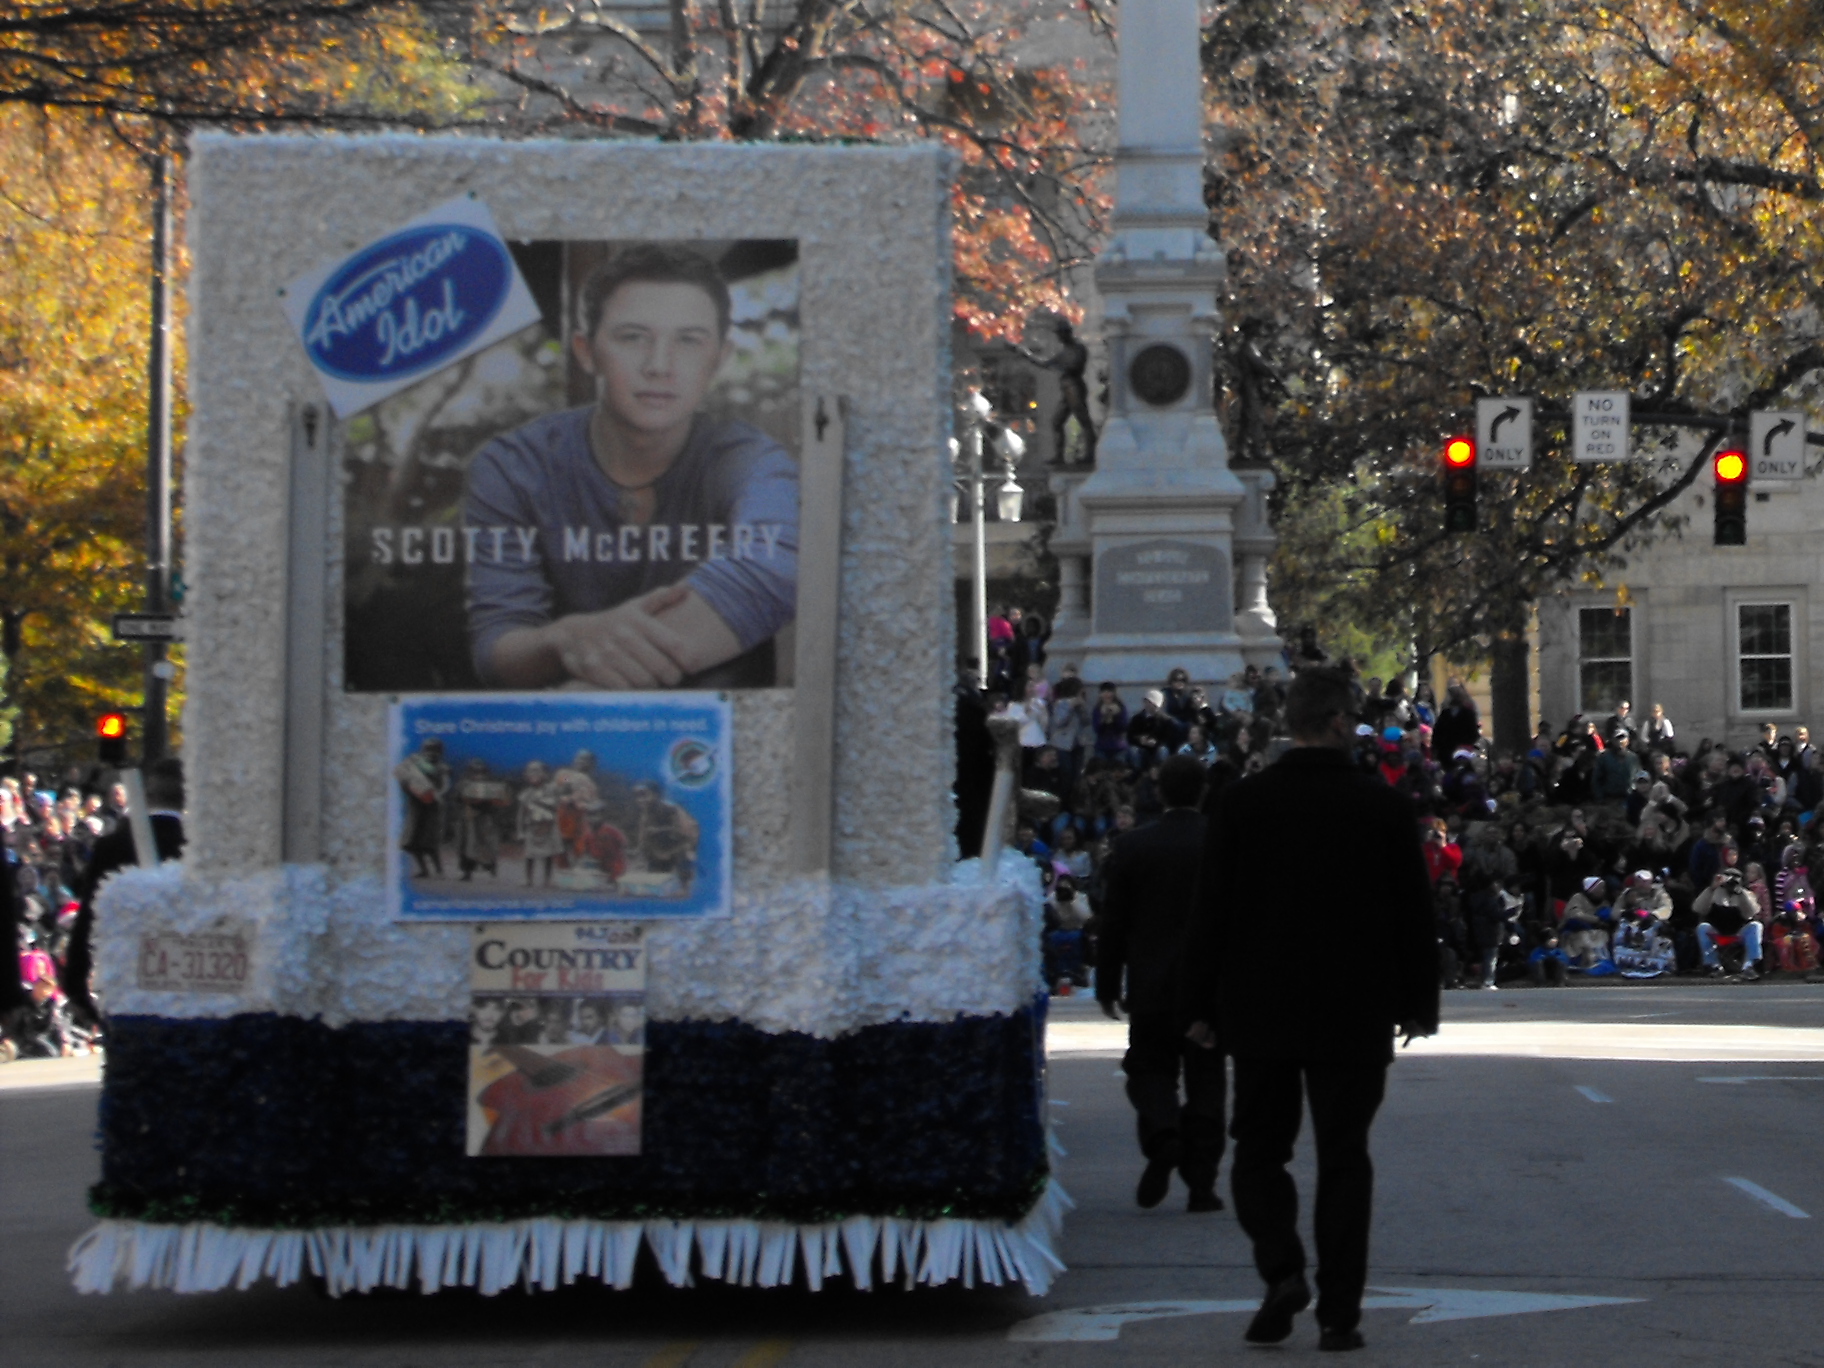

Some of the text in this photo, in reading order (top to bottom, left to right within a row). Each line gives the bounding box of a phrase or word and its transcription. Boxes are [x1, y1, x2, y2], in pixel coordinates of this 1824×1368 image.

[306, 232, 467, 350] American
[378, 277, 465, 367] Idol
[1588, 399, 1614, 411] NO
[1583, 416, 1621, 426] TURN
[1591, 430, 1611, 440] ON
[1485, 448, 1524, 461] ONLY
[1586, 443, 1615, 454] RED
[1758, 461, 1797, 473] ONLY
[372, 524, 784, 564] SCOTTY McCREERY
[476, 939, 642, 971] COUNTRY
[142, 950, 248, 981] CA-31320
[511, 966, 604, 991] For Kids
